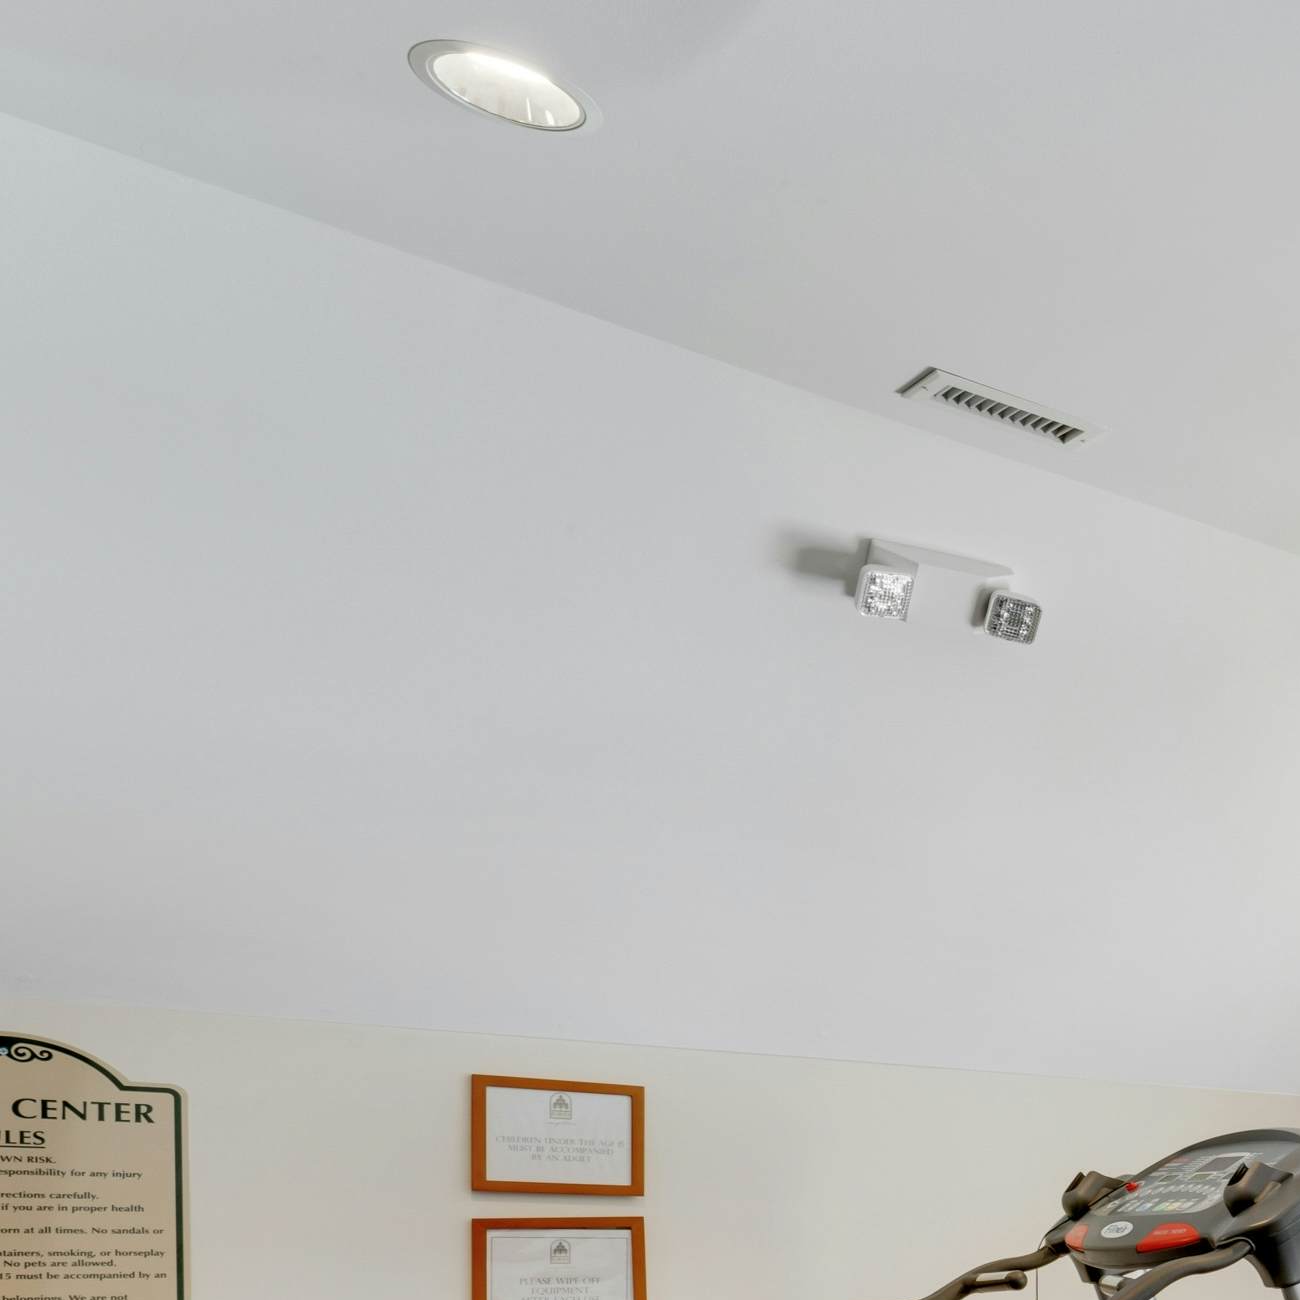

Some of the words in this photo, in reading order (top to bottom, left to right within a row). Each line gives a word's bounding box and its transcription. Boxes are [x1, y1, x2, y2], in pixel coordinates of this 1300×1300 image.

[11, 1098, 155, 1124] CENTER
[0, 1129, 46, 1146] LES
[70, 1168, 87, 1177] for
[89, 1171, 109, 1179] any
[112, 1169, 143, 1180] injury
[49, 1191, 99, 1201] carefully.
[1, 1203, 10, 1211] if
[12, 1205, 33, 1213] you
[57, 1203, 69, 1212] in
[71, 1205, 108, 1214] proper
[111, 1204, 145, 1213] health
[38, 1226, 51, 1234] all
[55, 1226, 88, 1235] times.
[91, 1227, 108, 1235] No
[111, 1227, 150, 1236] sandals
[47, 1249, 96, 1259] smoking,
[114, 1249, 166, 1259] horseplay
[24, 1260, 47, 1269] pets
[71, 1259, 117, 1268] allowed.
[46, 1272, 61, 1280] be
[63, 1271, 136, 1281] accompanied
[138, 1271, 151, 1281] by
